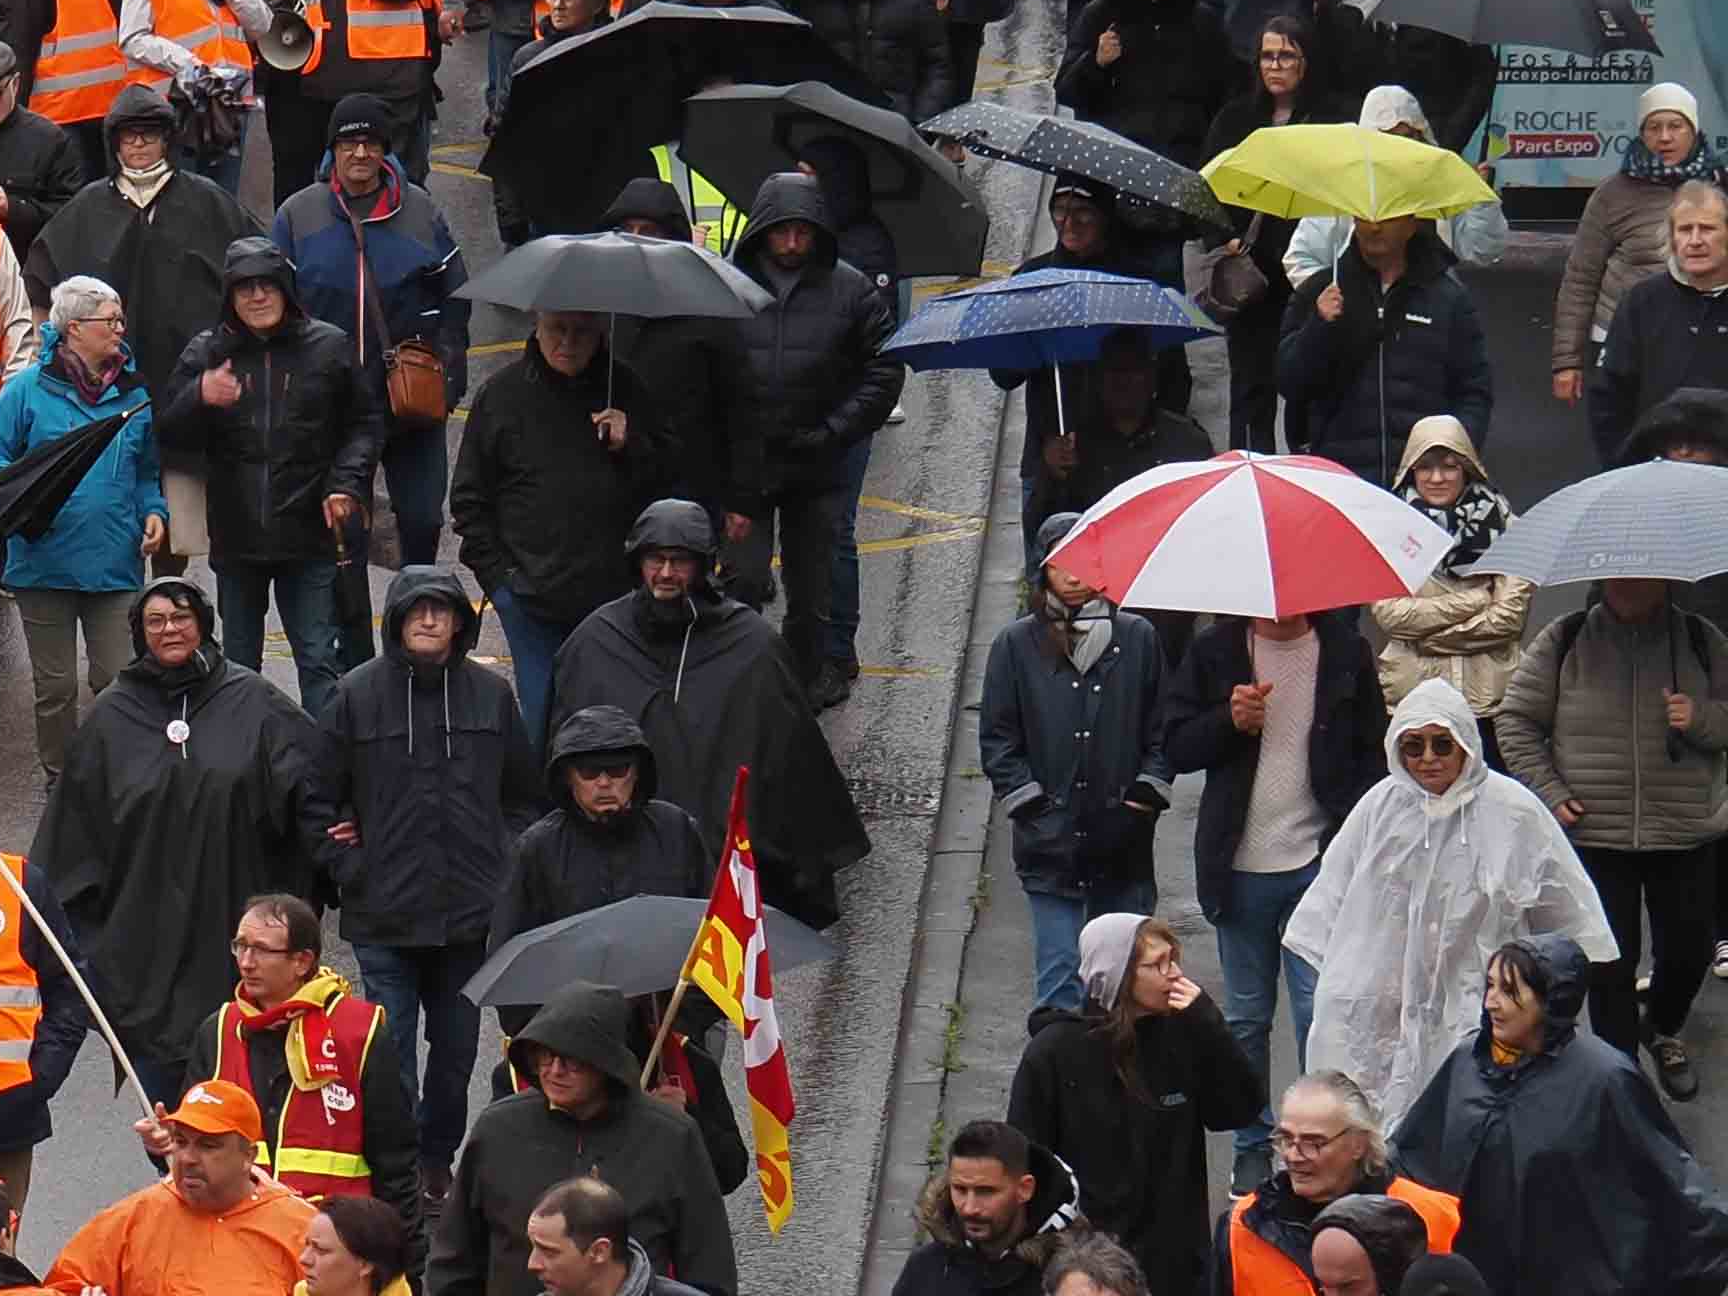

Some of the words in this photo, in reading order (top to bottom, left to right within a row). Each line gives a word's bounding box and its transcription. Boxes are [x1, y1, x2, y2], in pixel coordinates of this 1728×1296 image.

[1497, 65, 1651, 85] arcexpo-laroche.fr
[1514, 111, 1598, 132] ROCHE
[1514, 139, 1553, 157] Parc
[1555, 138, 1593, 160] Expo
